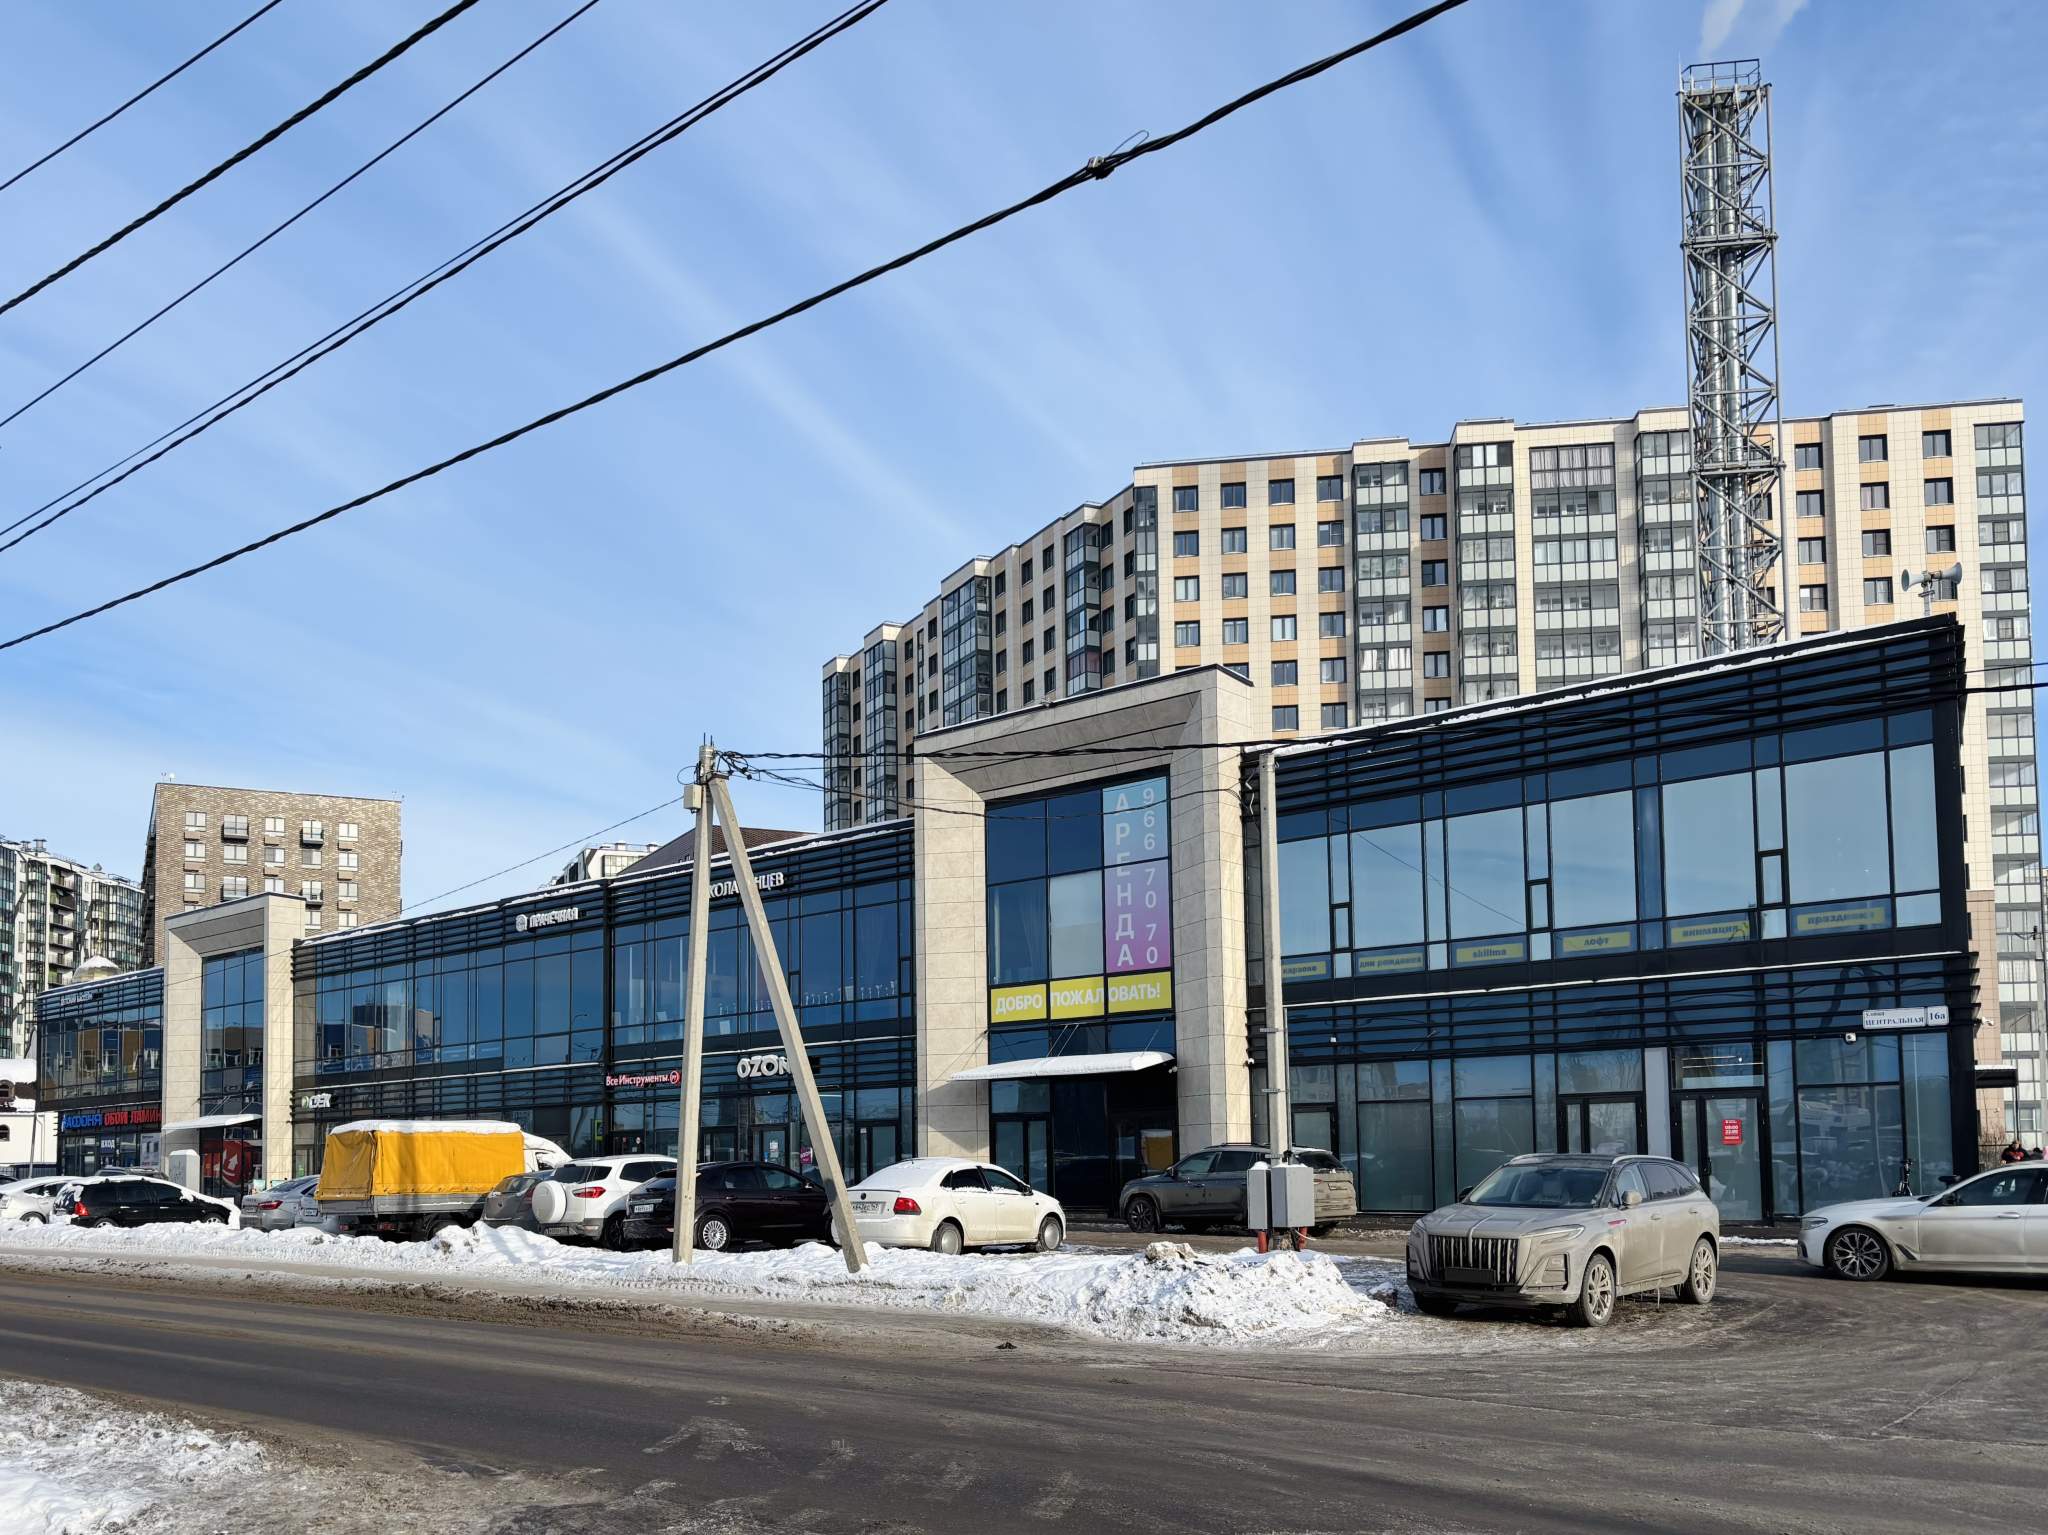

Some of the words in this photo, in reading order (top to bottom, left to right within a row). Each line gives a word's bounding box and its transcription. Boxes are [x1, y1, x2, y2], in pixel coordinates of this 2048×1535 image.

[709, 880, 740, 898] КОЛА
[752, 872, 784, 891] НЦЕВ
[1114, 793, 1135, 967] АРЕНДА
[529, 907, 579, 928] ПРАЧЕЧНАЯ
[995, 993, 1043, 1015] ДОБРО
[1050, 982, 1161, 1008] ПОЖАЛОВАТЬ!
[1865, 1017, 1924, 1026] ЦЕНТРАЛЬНАЯ
[737, 1054, 791, 1079] OZON
[104, 1111, 128, 1127] ОБОИ
[130, 1108, 161, 1125] ЛАМИН
